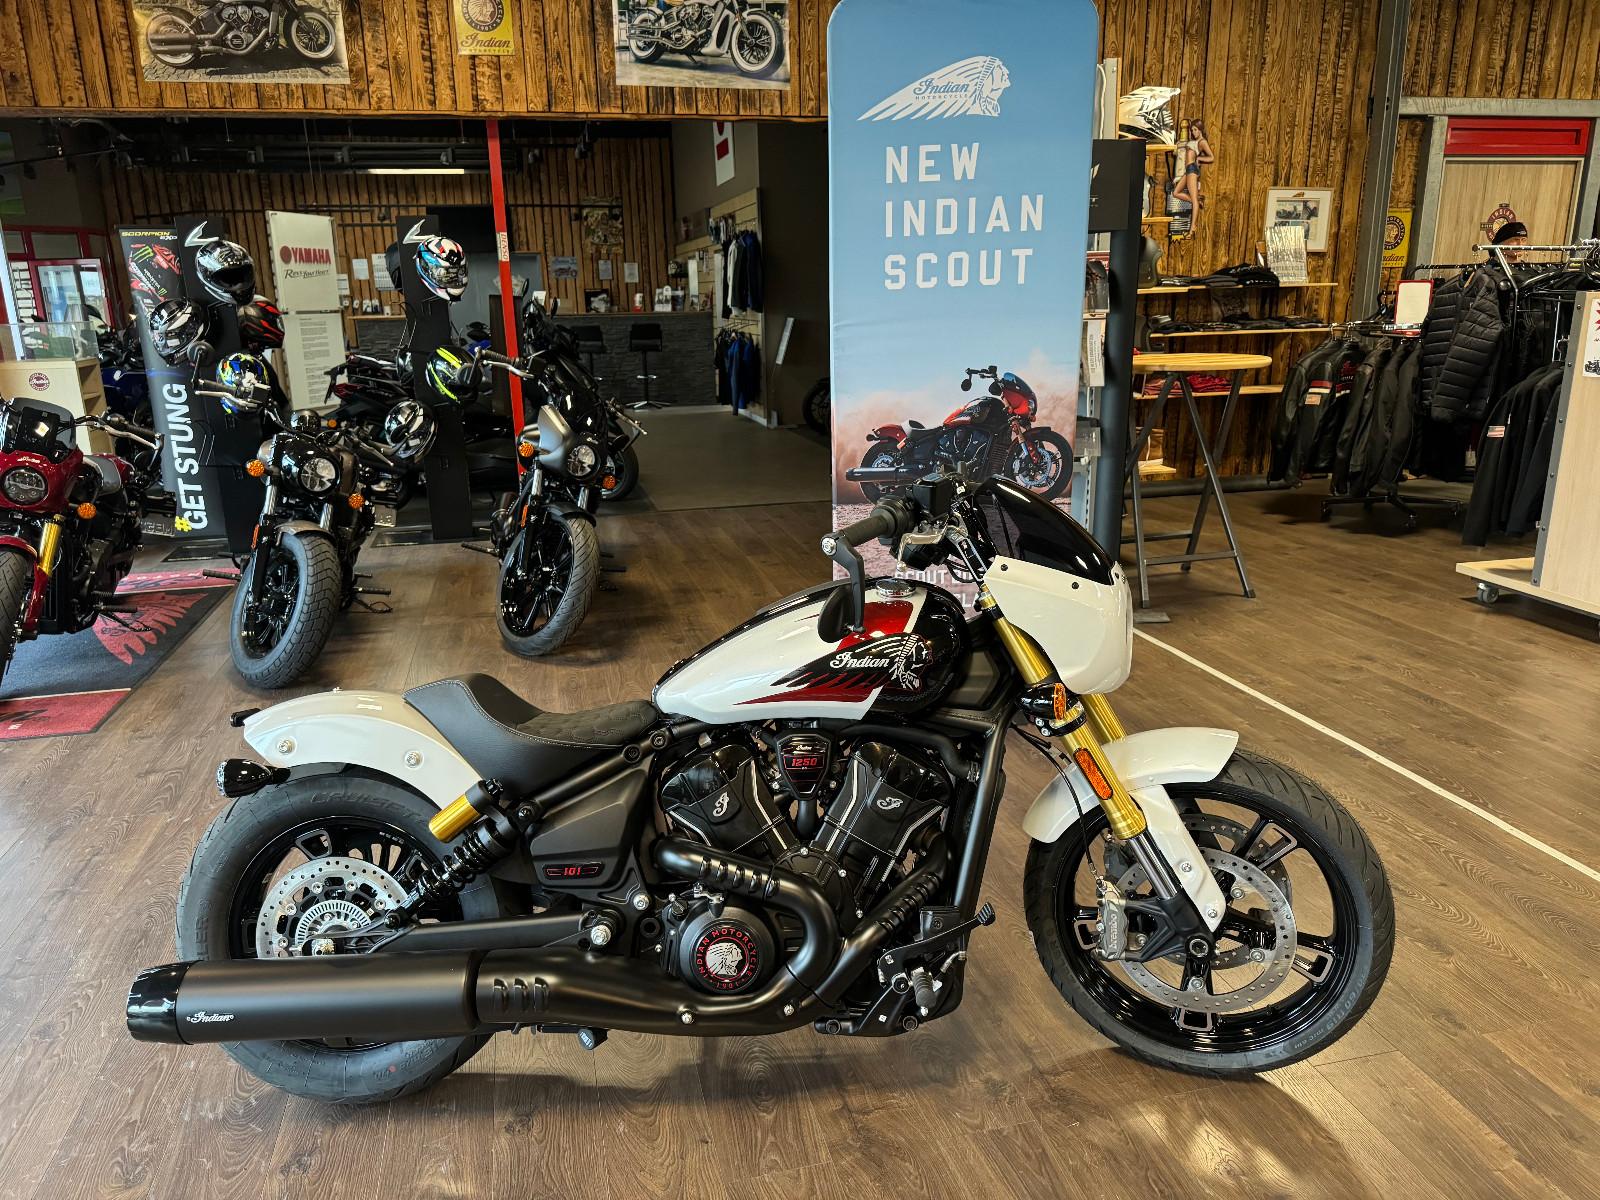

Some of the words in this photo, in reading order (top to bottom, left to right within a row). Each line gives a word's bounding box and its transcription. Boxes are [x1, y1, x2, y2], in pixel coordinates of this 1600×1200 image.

[461, 33, 511, 48] Indian
[913, 78, 969, 95] Indian
[885, 142, 980, 184] NEW
[885, 194, 1044, 237] INDIAN
[291, 247, 332, 264] YAMAHA
[884, 248, 1034, 290] SCOUT
[162, 384, 199, 475] STUNG
[175, 478, 208, 532] #GET
[829, 651, 890, 669] Indian
[792, 758, 817, 767] 1250
[564, 867, 582, 876] 101
[1109, 913, 1118, 949] brembo
[697, 938, 710, 978] INDIAN
[711, 928, 757, 977] MOTORCYCLE
[190, 1011, 231, 1024] Indian
